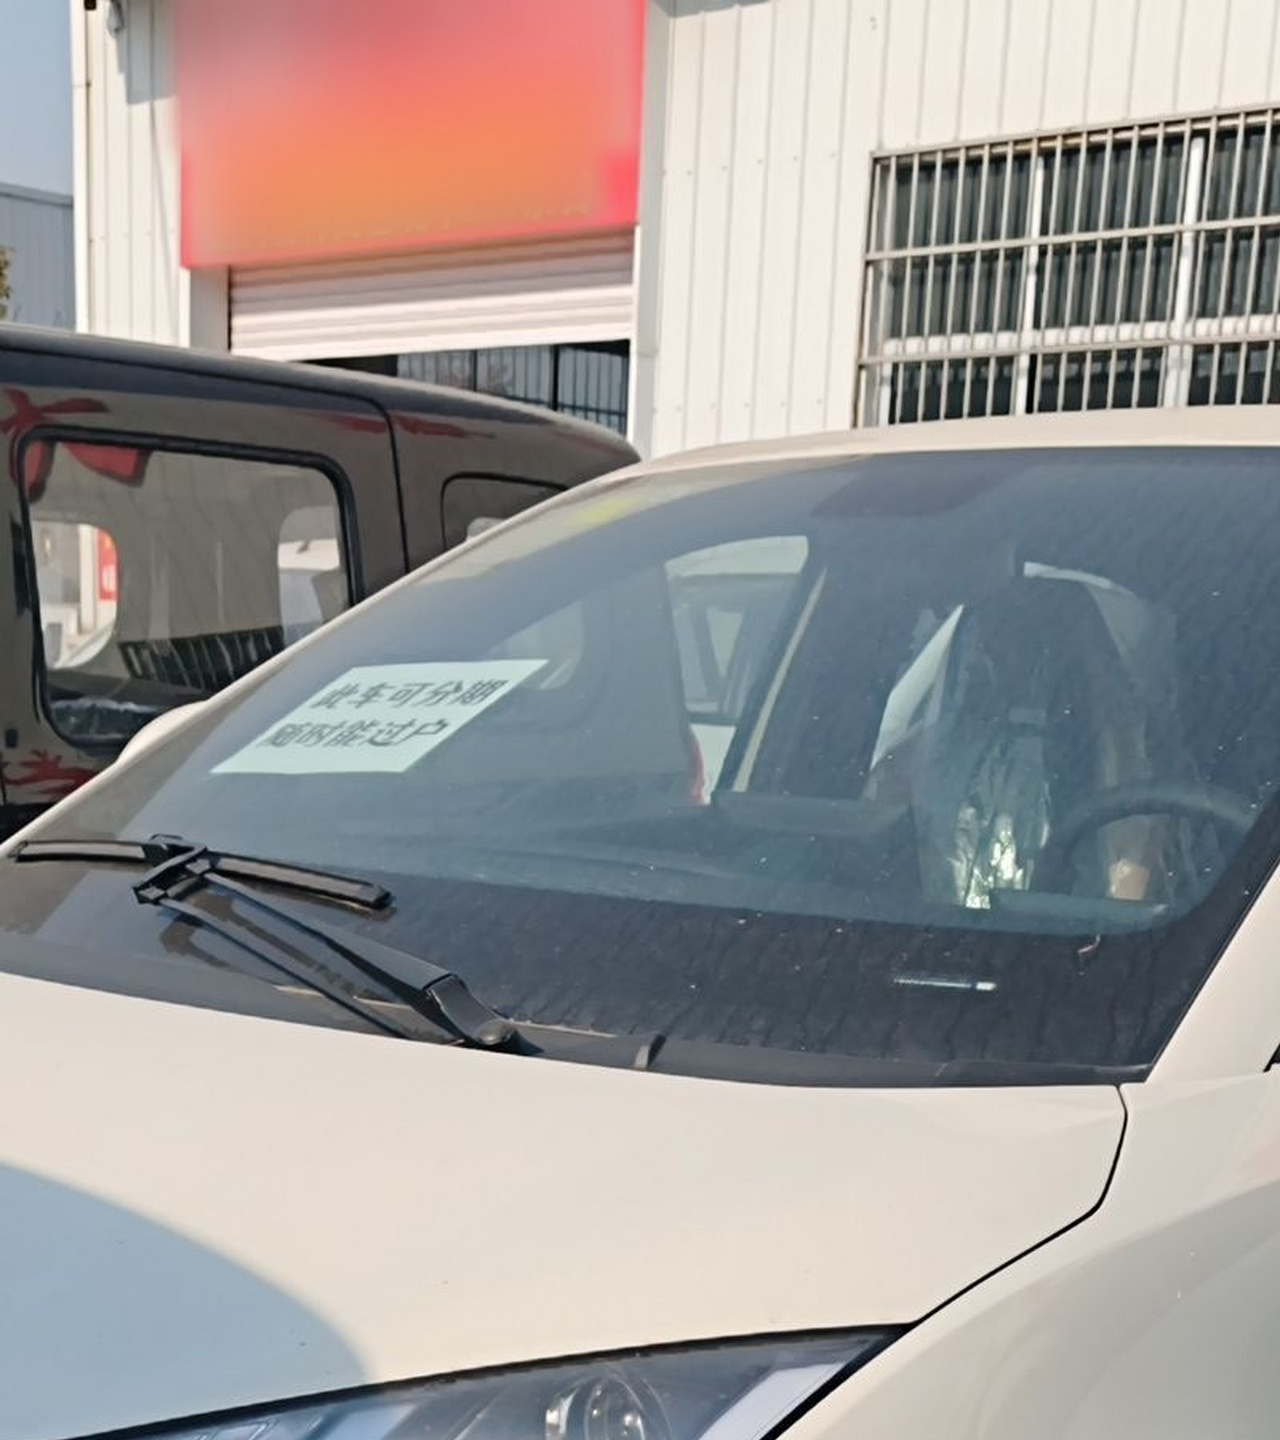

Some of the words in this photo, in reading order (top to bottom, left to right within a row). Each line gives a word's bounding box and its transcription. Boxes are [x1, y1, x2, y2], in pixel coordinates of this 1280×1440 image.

[311, 679, 509, 709] 此车可分期
[261, 717, 450, 747] 随时能过户
